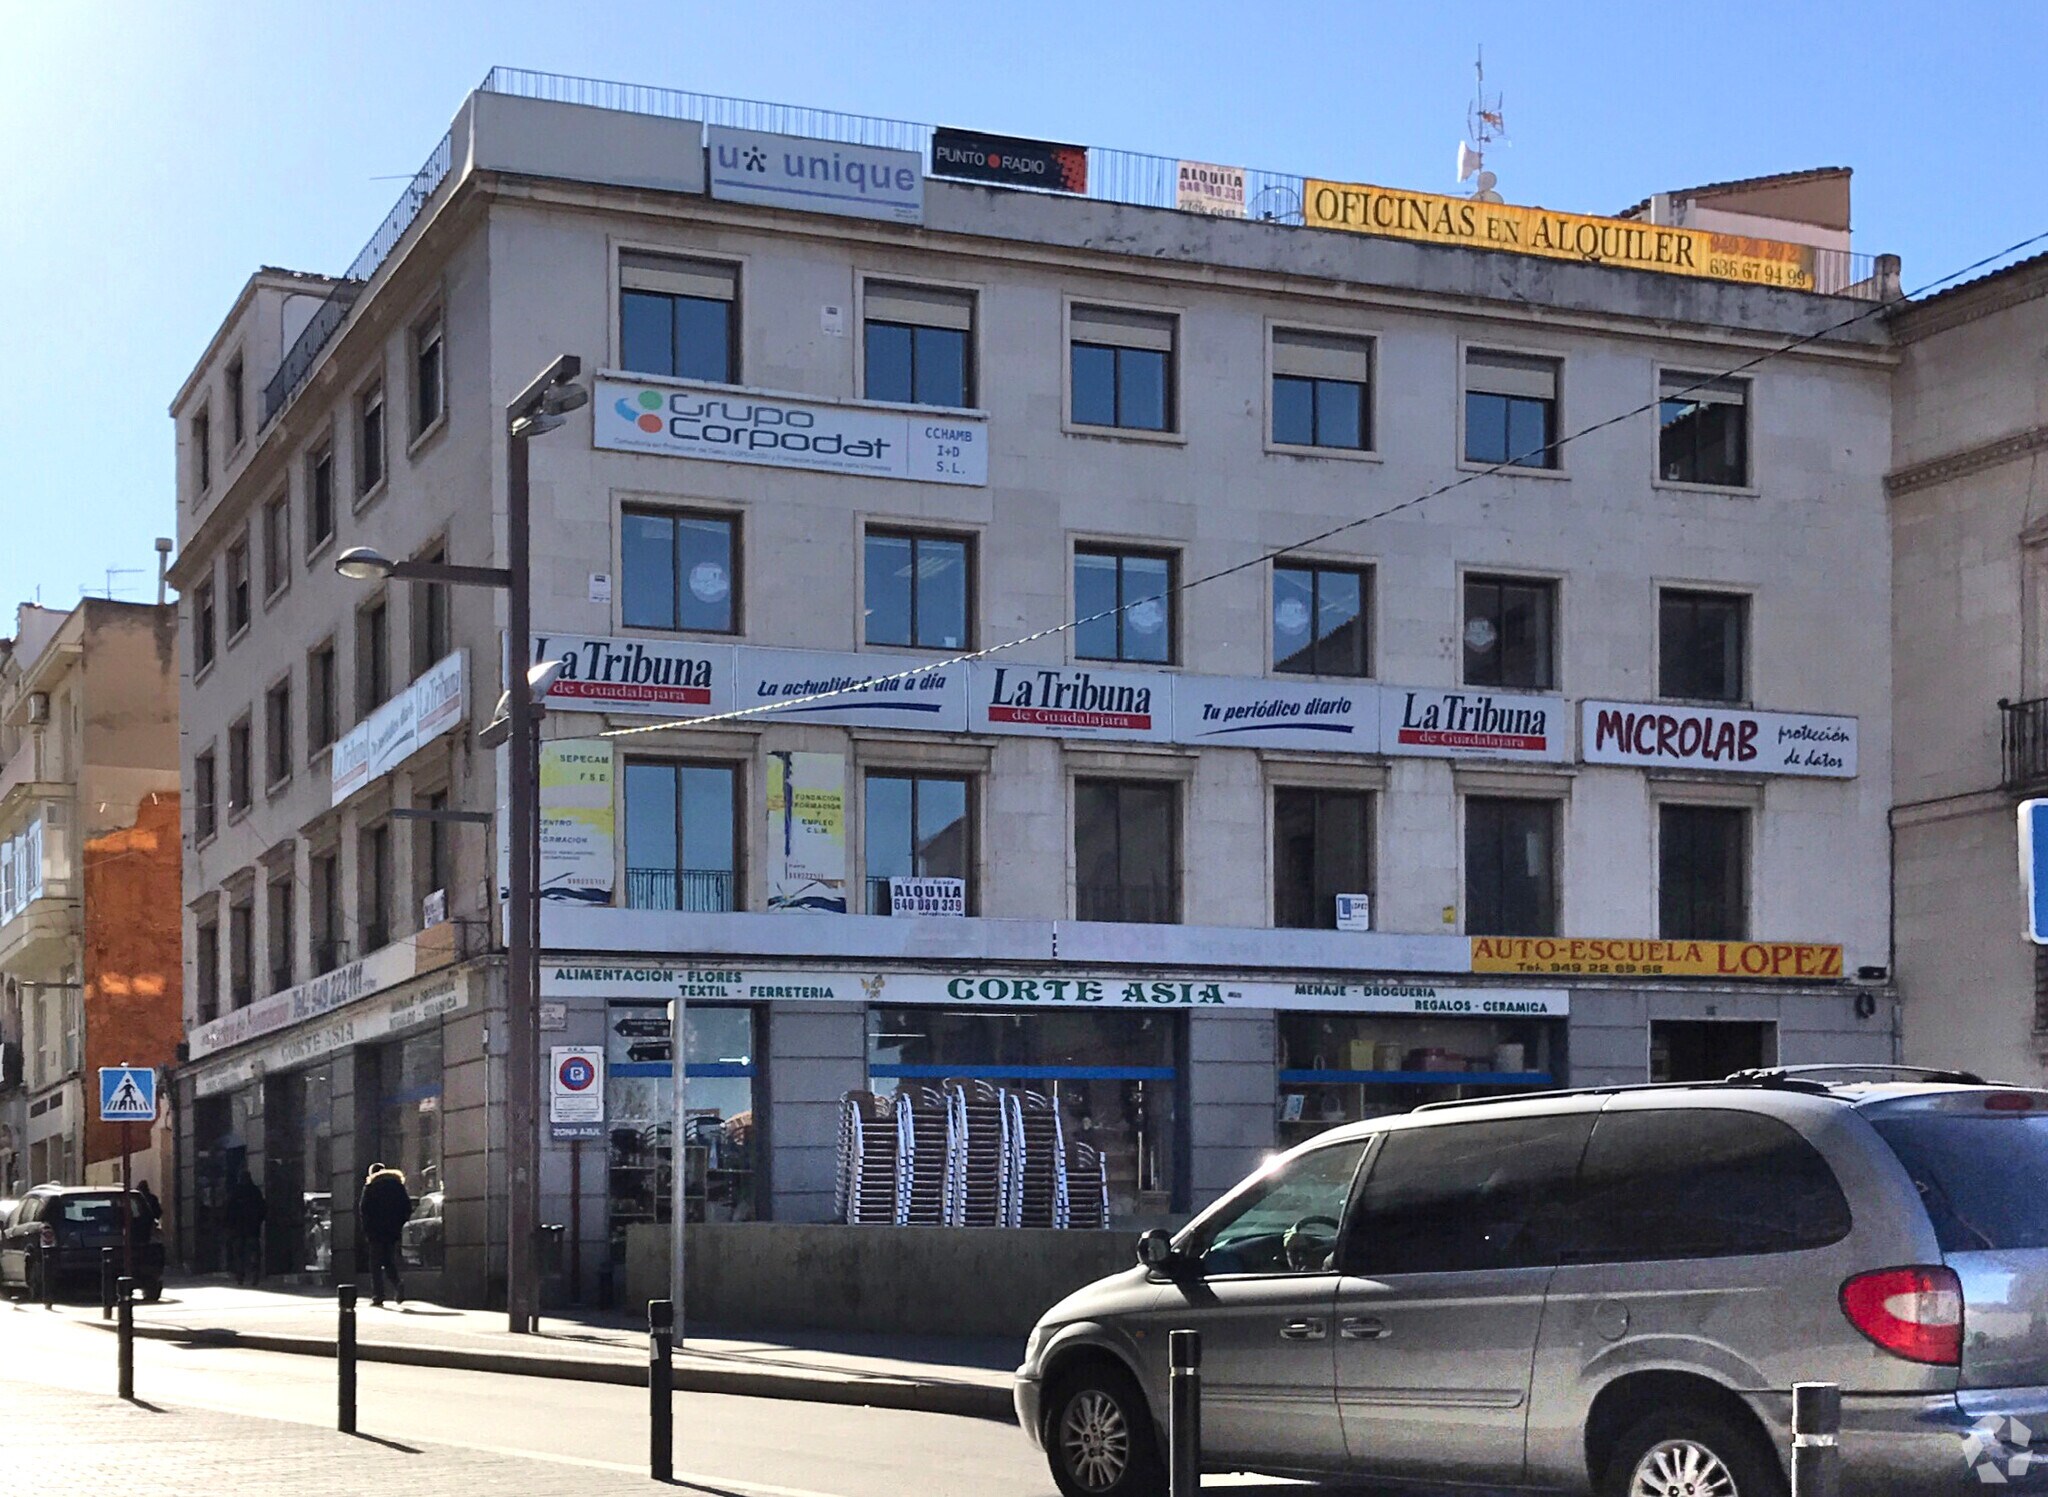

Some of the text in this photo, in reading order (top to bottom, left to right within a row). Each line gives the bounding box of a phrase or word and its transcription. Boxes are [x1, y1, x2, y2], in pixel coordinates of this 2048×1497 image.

[936, 146, 1046, 175] PUNTO RADIO
[784, 153, 915, 194] unique
[1180, 167, 1243, 188] ALQUILA
[1315, 187, 1476, 238] OFICINAS
[1486, 216, 1521, 244] EN
[1531, 215, 1697, 269] ALQUILER
[1709, 257, 1806, 287] 636 67 94 99
[669, 392, 814, 428] Grupo
[669, 416, 891, 460] Corpodat
[925, 427, 973, 443] CCHAMB
[936, 445, 960, 459] I+D
[936, 461, 966, 475] S.L.
[583, 641, 712, 688] Tribuna
[553, 682, 685, 702] de Guadalajara
[757, 679, 778, 697] La
[781, 676, 872, 697] actualidad
[904, 677, 917, 691] a
[919, 672, 947, 690] día
[990, 667, 1151, 714] La Tribuna
[1011, 711, 1129, 728] de Guadalajara
[1203, 696, 1352, 723] Tu periódico diario
[1402, 692, 1547, 736] La Tribuna
[1419, 731, 1525, 748] de Guadalajara
[1595, 709, 1759, 763] MICROLAB
[1777, 724, 1850, 745] protección
[559, 754, 609, 764] SEPECAM
[1783, 748, 1843, 769] de datos
[801, 818, 834, 827] EMPLEO
[894, 884, 962, 899] ALQUILA
[894, 898, 915, 911] 640
[942, 899, 962, 912] 339
[1473, 936, 1841, 976] AUTO-ESCUELA LOPEZ
[554, 968, 674, 983] ALIMENTACION
[687, 971, 743, 984] FLORES
[1550, 963, 1582, 972] 949
[679, 984, 729, 998] TEXTIL
[749, 986, 834, 999] FERRETERIA
[947, 977, 1226, 1004] CORTE ASIA
[1295, 984, 1347, 997] MENAJE
[1364, 986, 1437, 998] DROGUERIA
[1414, 1000, 1472, 1012] REGALOS
[1483, 1001, 1548, 1014] CERAMICA
